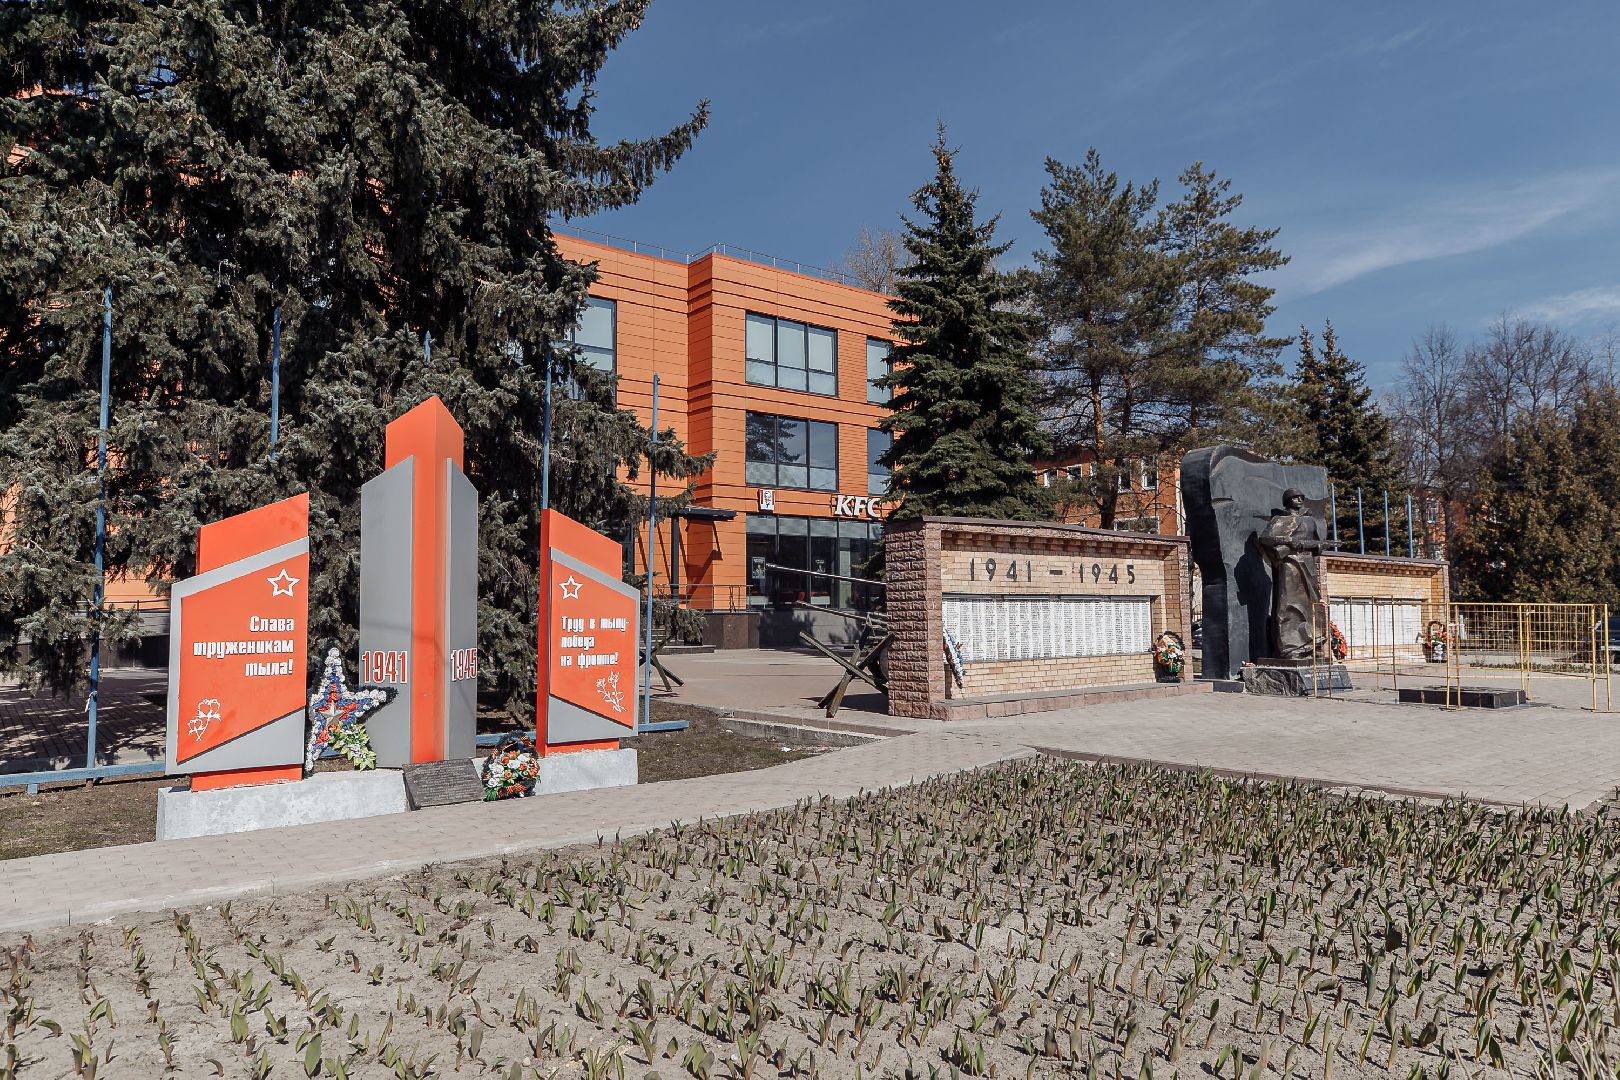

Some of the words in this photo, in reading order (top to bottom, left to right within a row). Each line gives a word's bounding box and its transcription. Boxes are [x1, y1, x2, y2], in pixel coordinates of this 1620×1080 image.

[835, 495, 881, 517] KFC
[970, 558, 1032, 582] 1941
[1079, 563, 1135, 584] 1945
[249, 615, 295, 632] Слава
[561, 616, 584, 632] Труд
[589, 619, 596, 630] в
[193, 638, 294, 658] труженикам
[561, 634, 595, 650] победа
[245, 659, 294, 676] тыла!
[361, 651, 409, 683] 1941
[450, 647, 478, 681] 1945
[561, 655, 572, 666] на
[577, 652, 618, 669] фронте!
